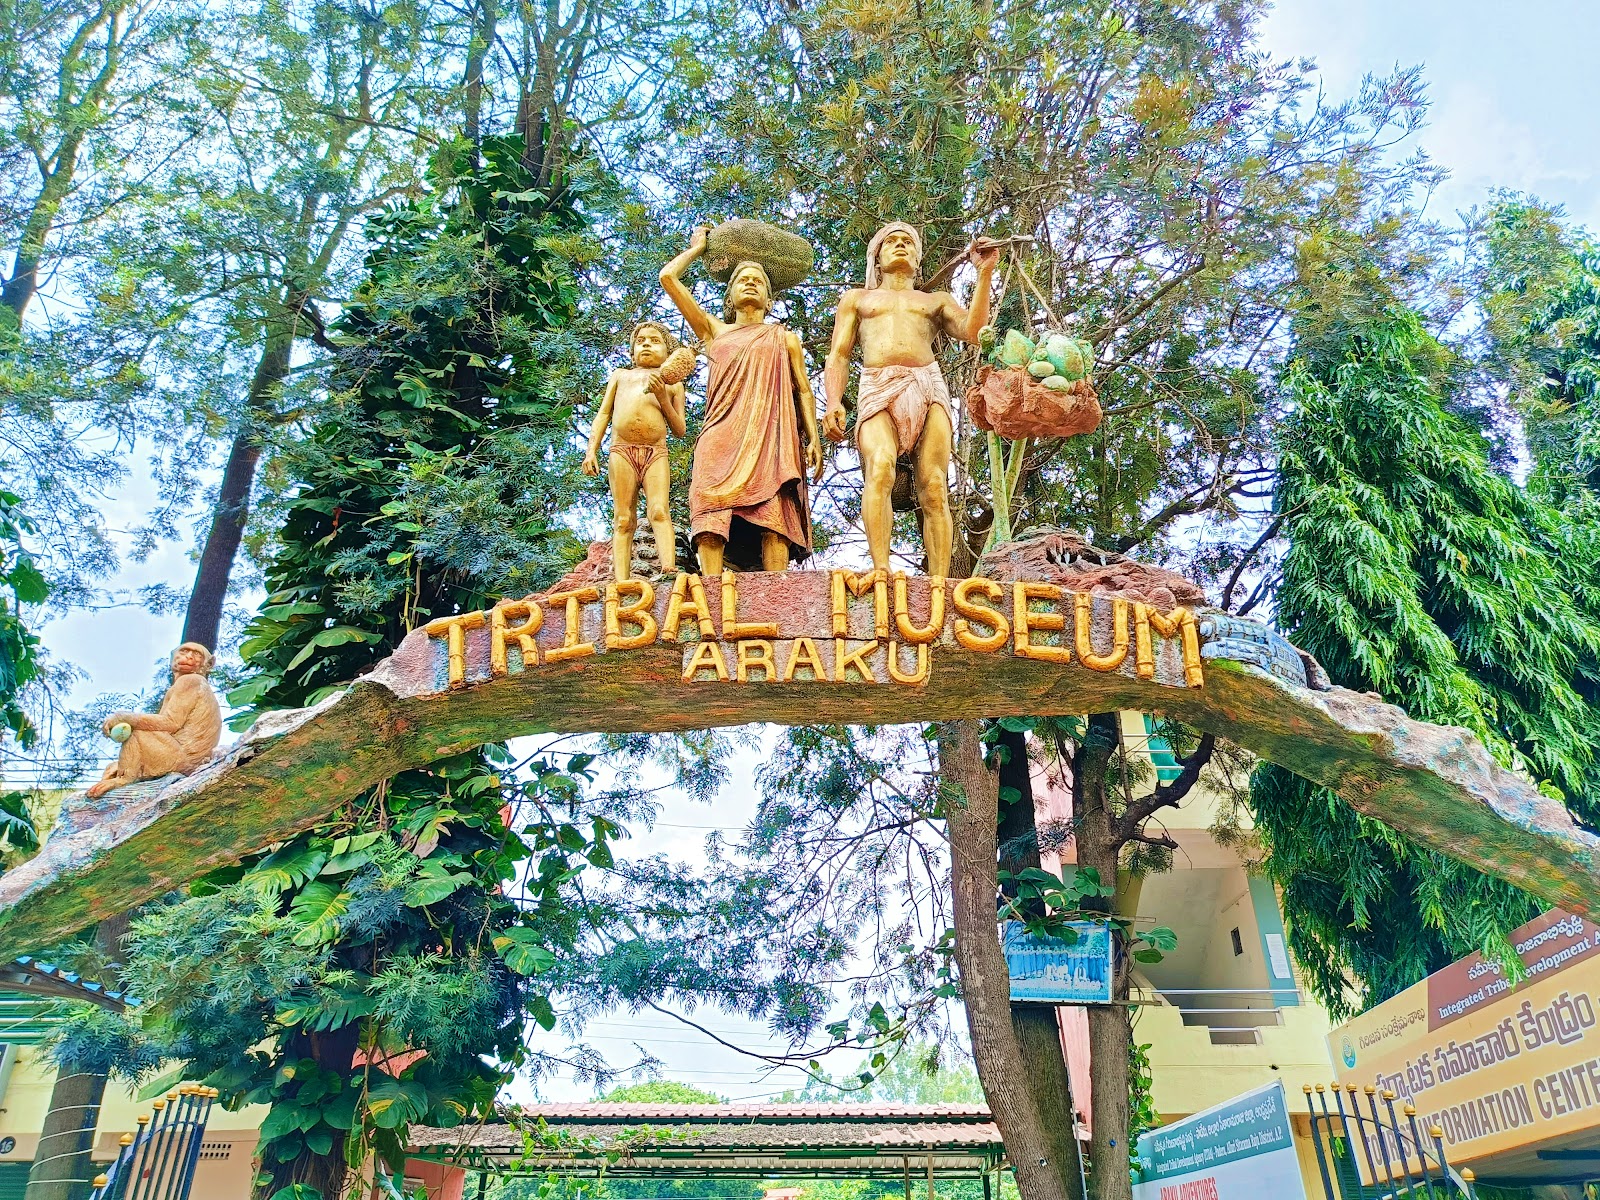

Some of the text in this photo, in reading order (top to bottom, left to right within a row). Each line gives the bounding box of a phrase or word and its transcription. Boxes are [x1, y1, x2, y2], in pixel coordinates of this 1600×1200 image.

[426, 569, 1203, 689] TRIBAL MUSEUM
[681, 638, 928, 686] ARAKU
[1438, 988, 1485, 1018] Integrated
[1485, 978, 1512, 997] Triba
[1517, 937, 1591, 981] evelopment
[1468, 955, 1503, 979] సమీకృ
[1434, 1017, 1520, 1083] సమాచార
[1516, 992, 1596, 1050] కేంద్రం
[1365, 1122, 1418, 1166] ORST
[1534, 1058, 1600, 1119] CENTE
